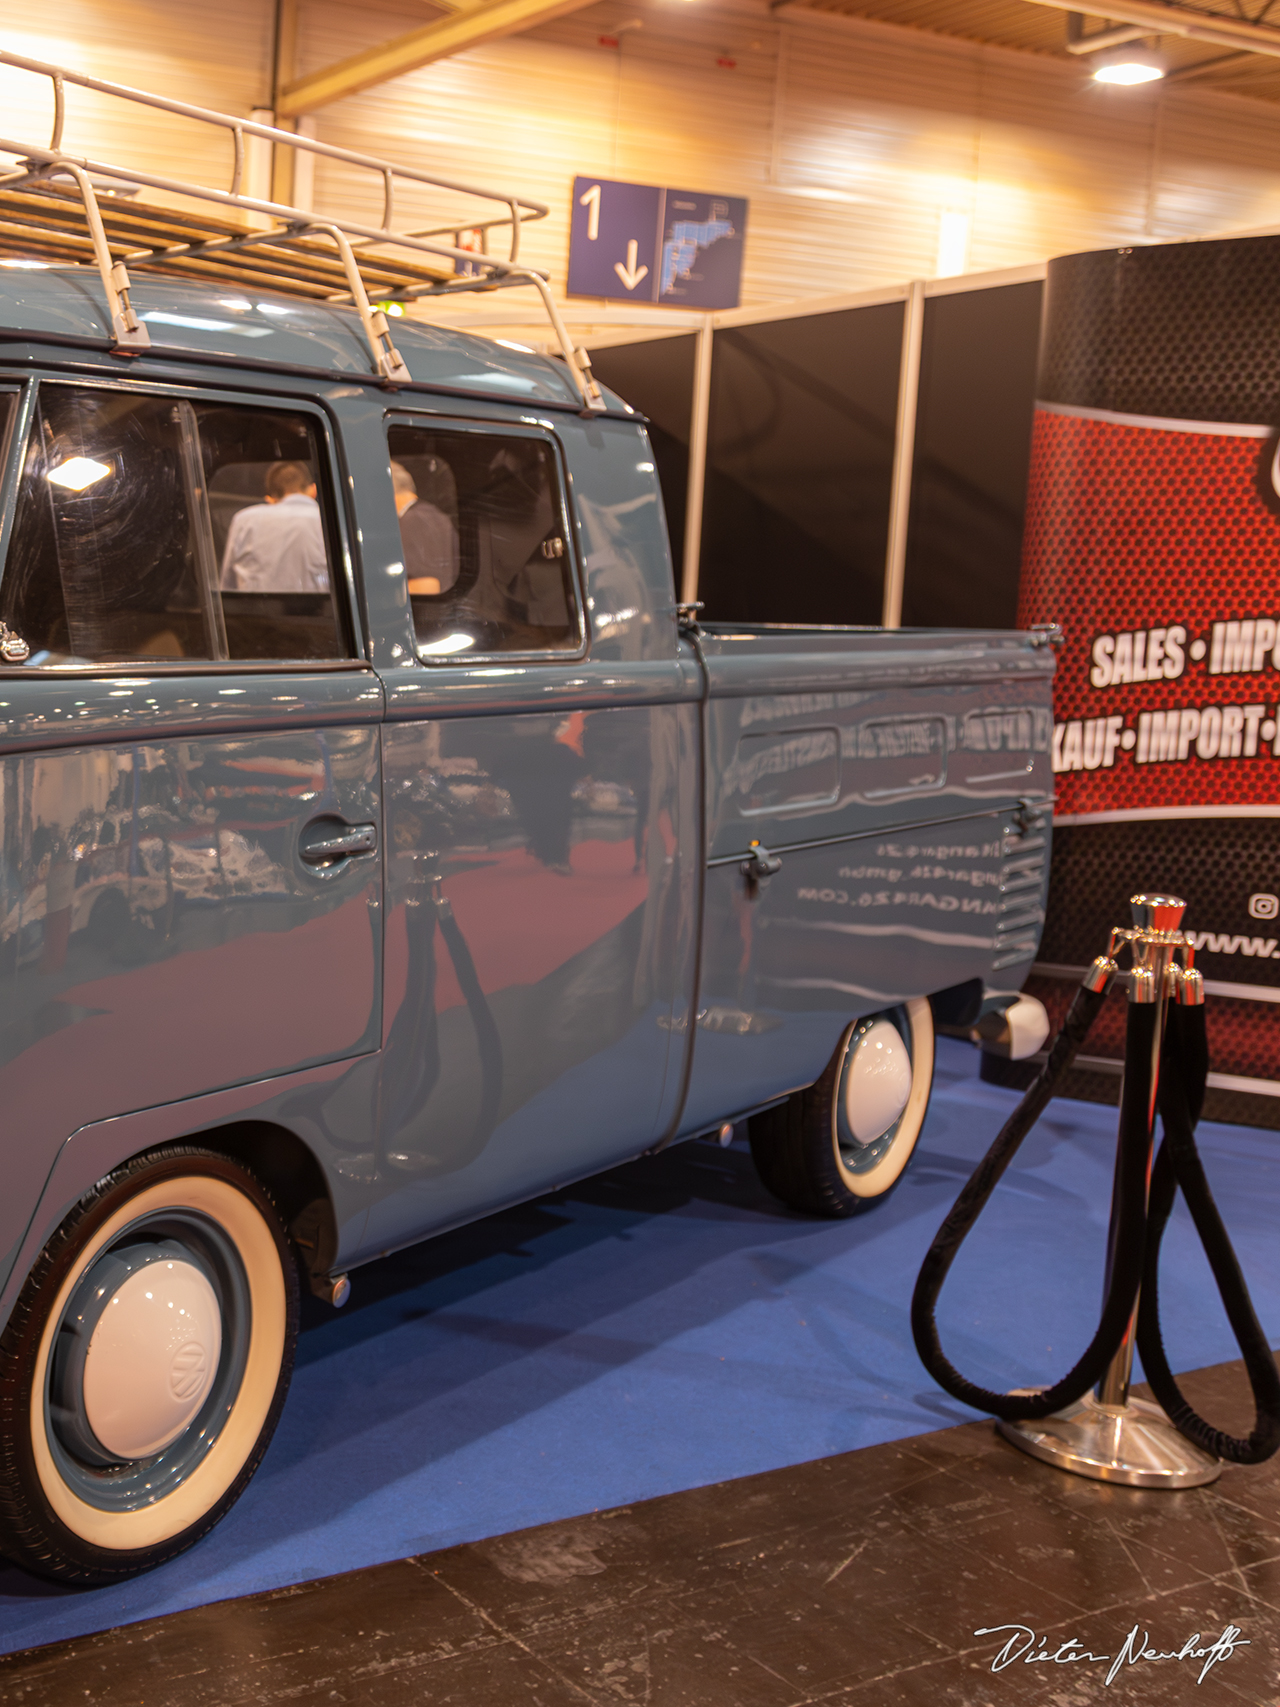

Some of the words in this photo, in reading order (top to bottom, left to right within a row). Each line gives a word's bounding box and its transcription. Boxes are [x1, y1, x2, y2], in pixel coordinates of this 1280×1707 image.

[579, 184, 602, 241] 1
[1090, 625, 1187, 688] SALES
[1136, 704, 1266, 763] IMPORT
